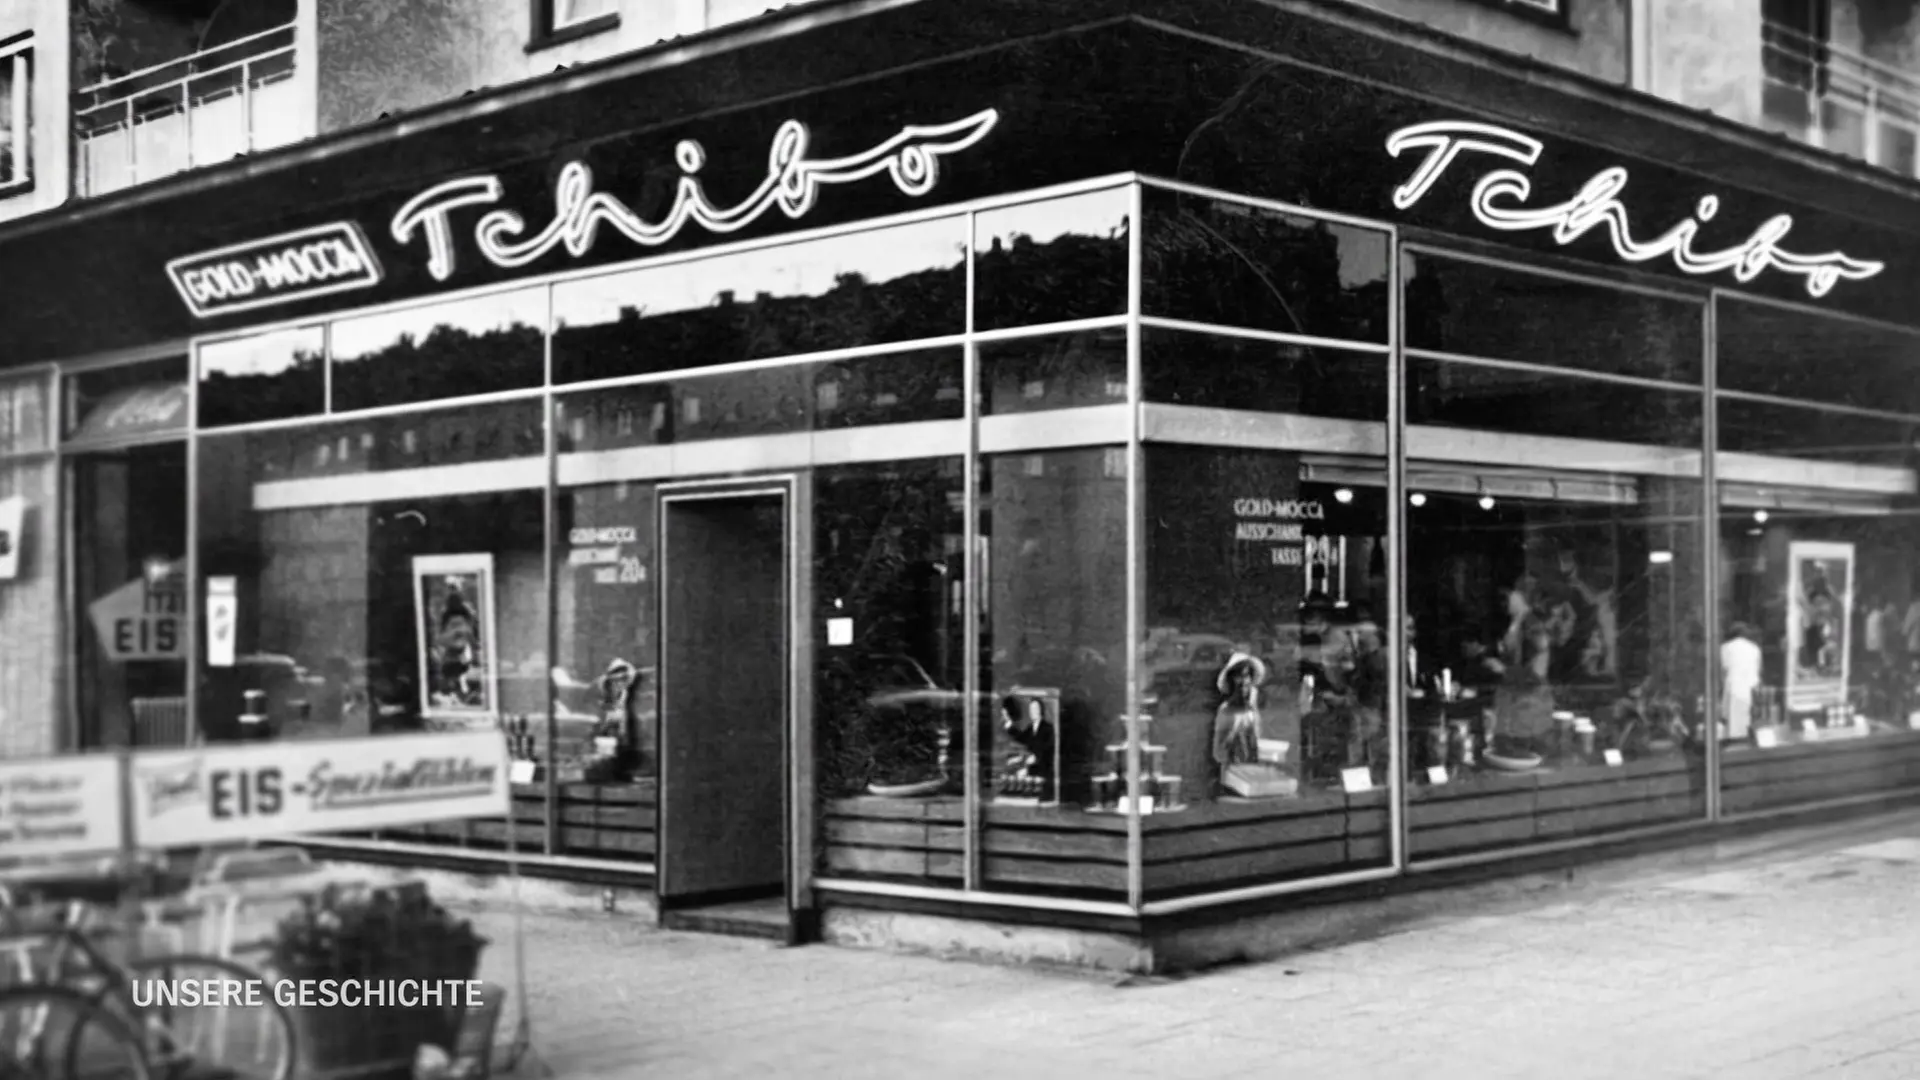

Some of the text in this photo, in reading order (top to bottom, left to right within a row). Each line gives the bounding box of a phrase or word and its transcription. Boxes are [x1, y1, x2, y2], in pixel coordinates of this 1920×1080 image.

[391, 108, 998, 280] Tchibo
[1385, 120, 1885, 298] Tchibo
[182, 237, 363, 303] GOLD-MOCCA
[115, 618, 177, 653] EIS
